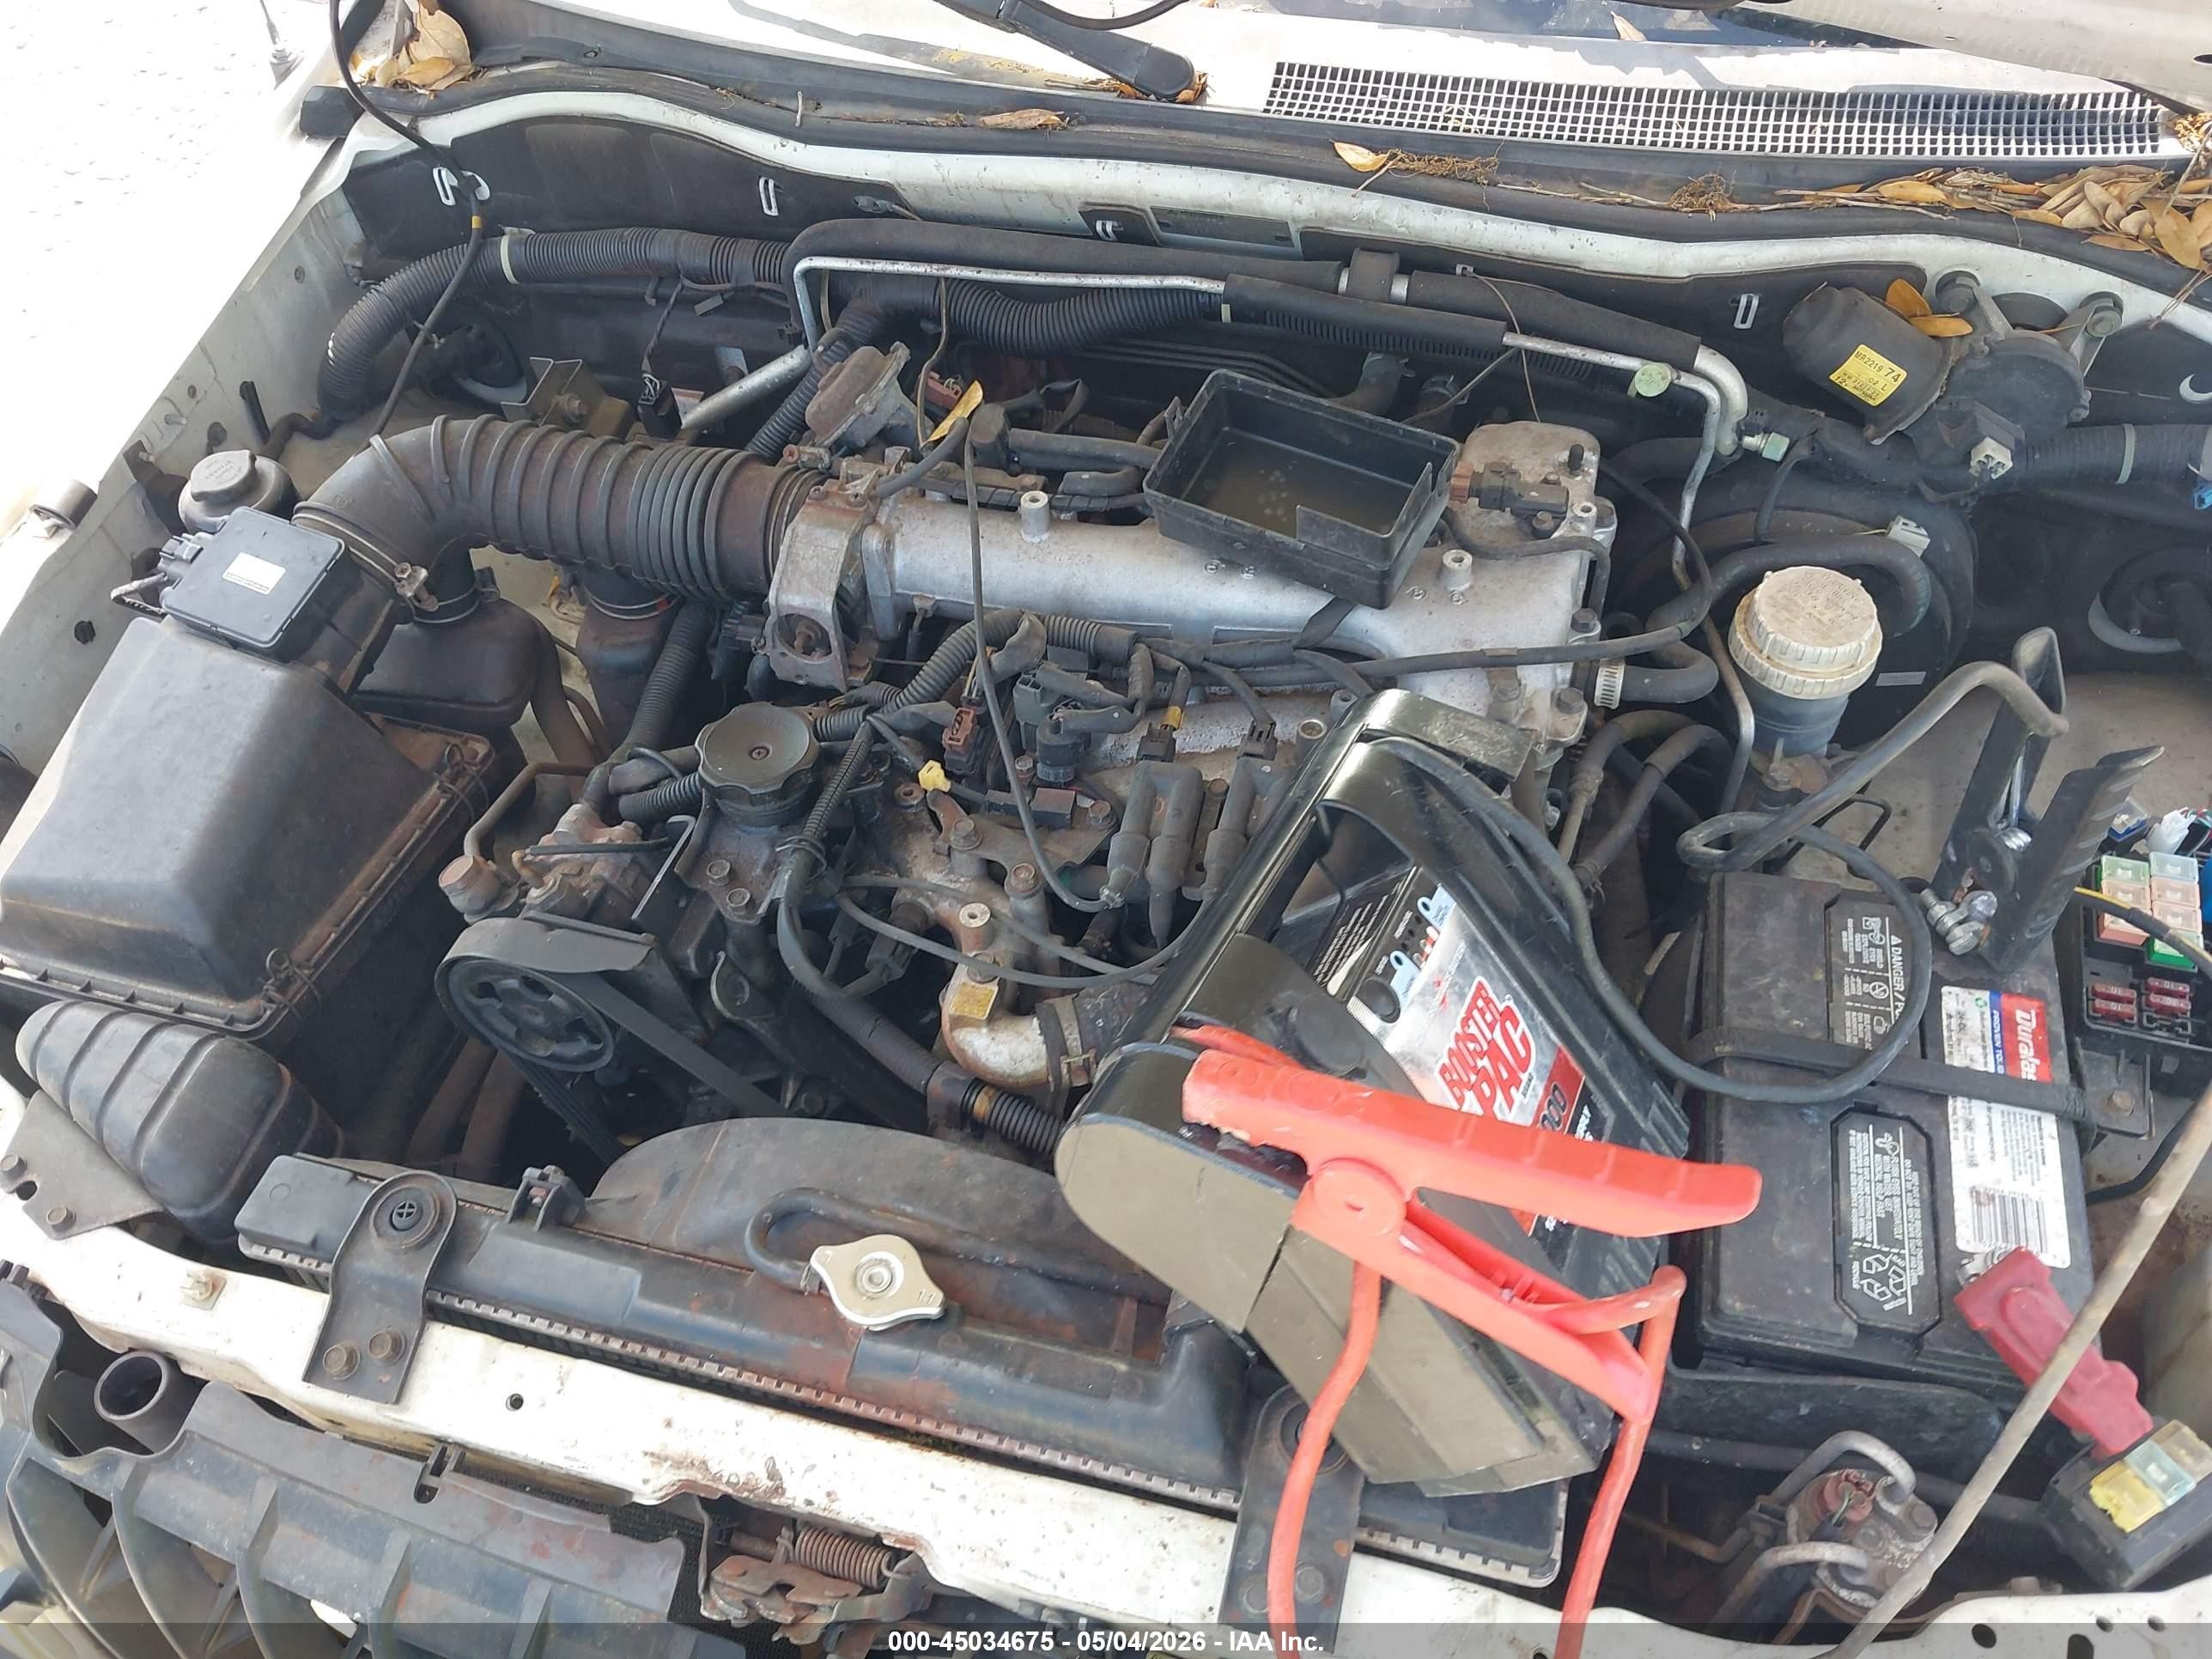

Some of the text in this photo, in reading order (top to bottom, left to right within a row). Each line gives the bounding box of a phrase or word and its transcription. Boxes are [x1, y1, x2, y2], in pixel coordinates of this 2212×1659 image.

[1854, 350, 1901, 383] MR2219 74
[1437, 979, 1503, 1111] BOOSTER
[1470, 1004, 1533, 1115] PAC
